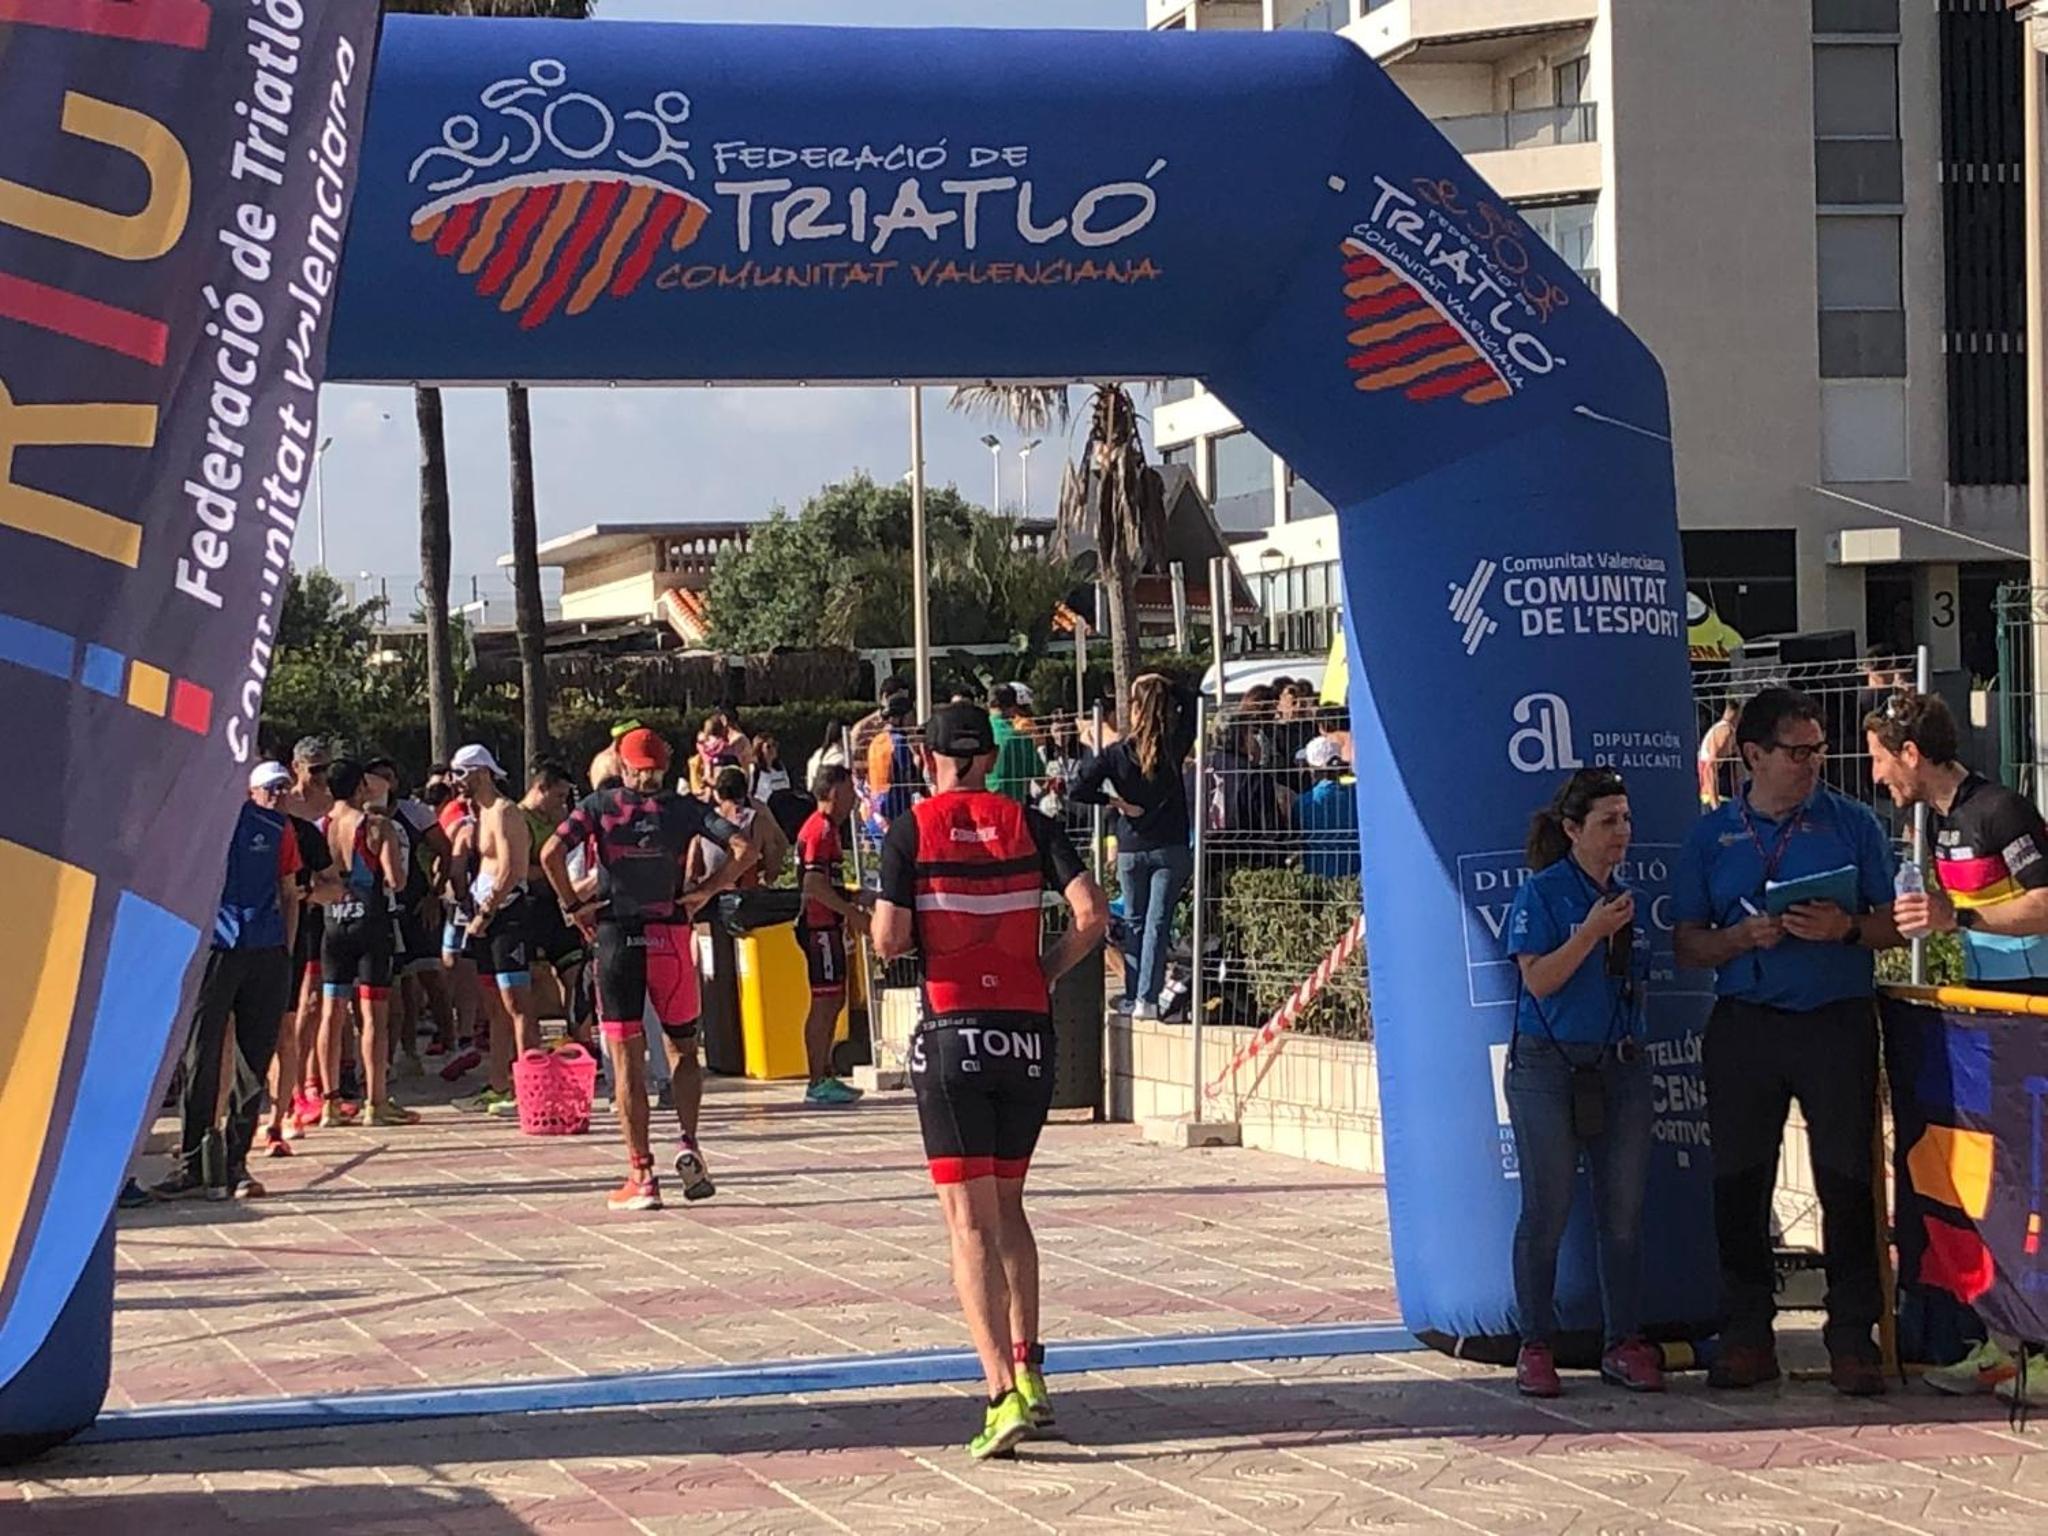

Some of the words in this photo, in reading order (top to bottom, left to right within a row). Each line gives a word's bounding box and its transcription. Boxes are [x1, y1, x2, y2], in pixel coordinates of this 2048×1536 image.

[231, 0, 304, 185] Triatló
[713, 138, 948, 174] FEDERACIÓ
[969, 145, 1029, 168] DE
[715, 157, 1168, 253] TRIATLÓ
[219, 203, 277, 281] de
[1428, 208, 1517, 288] FEDERACIÓ
[655, 259, 899, 290] COMUNITAT
[911, 257, 1163, 288] VALENCIANA
[1370, 175, 1567, 374] TRIATLÓ
[1353, 222, 1447, 292] COMUNITAT
[1447, 292, 1526, 390] VALENCIANA
[175, 285, 264, 608] Federació
[1502, 553, 1594, 573] Comunitat
[1597, 551, 1667, 573] Valenciana
[1503, 575, 1667, 607] COMUNITAT
[1521, 607, 1565, 637] DE
[1573, 606, 1680, 638] L'ESPORT
[1932, 591, 1955, 628] 3
[1592, 731, 1681, 748] DIPUTACIÓN
[1594, 753, 1616, 768] DE
[1621, 753, 1682, 769] ALICANTE
[957, 1028, 1041, 1060] TONI
